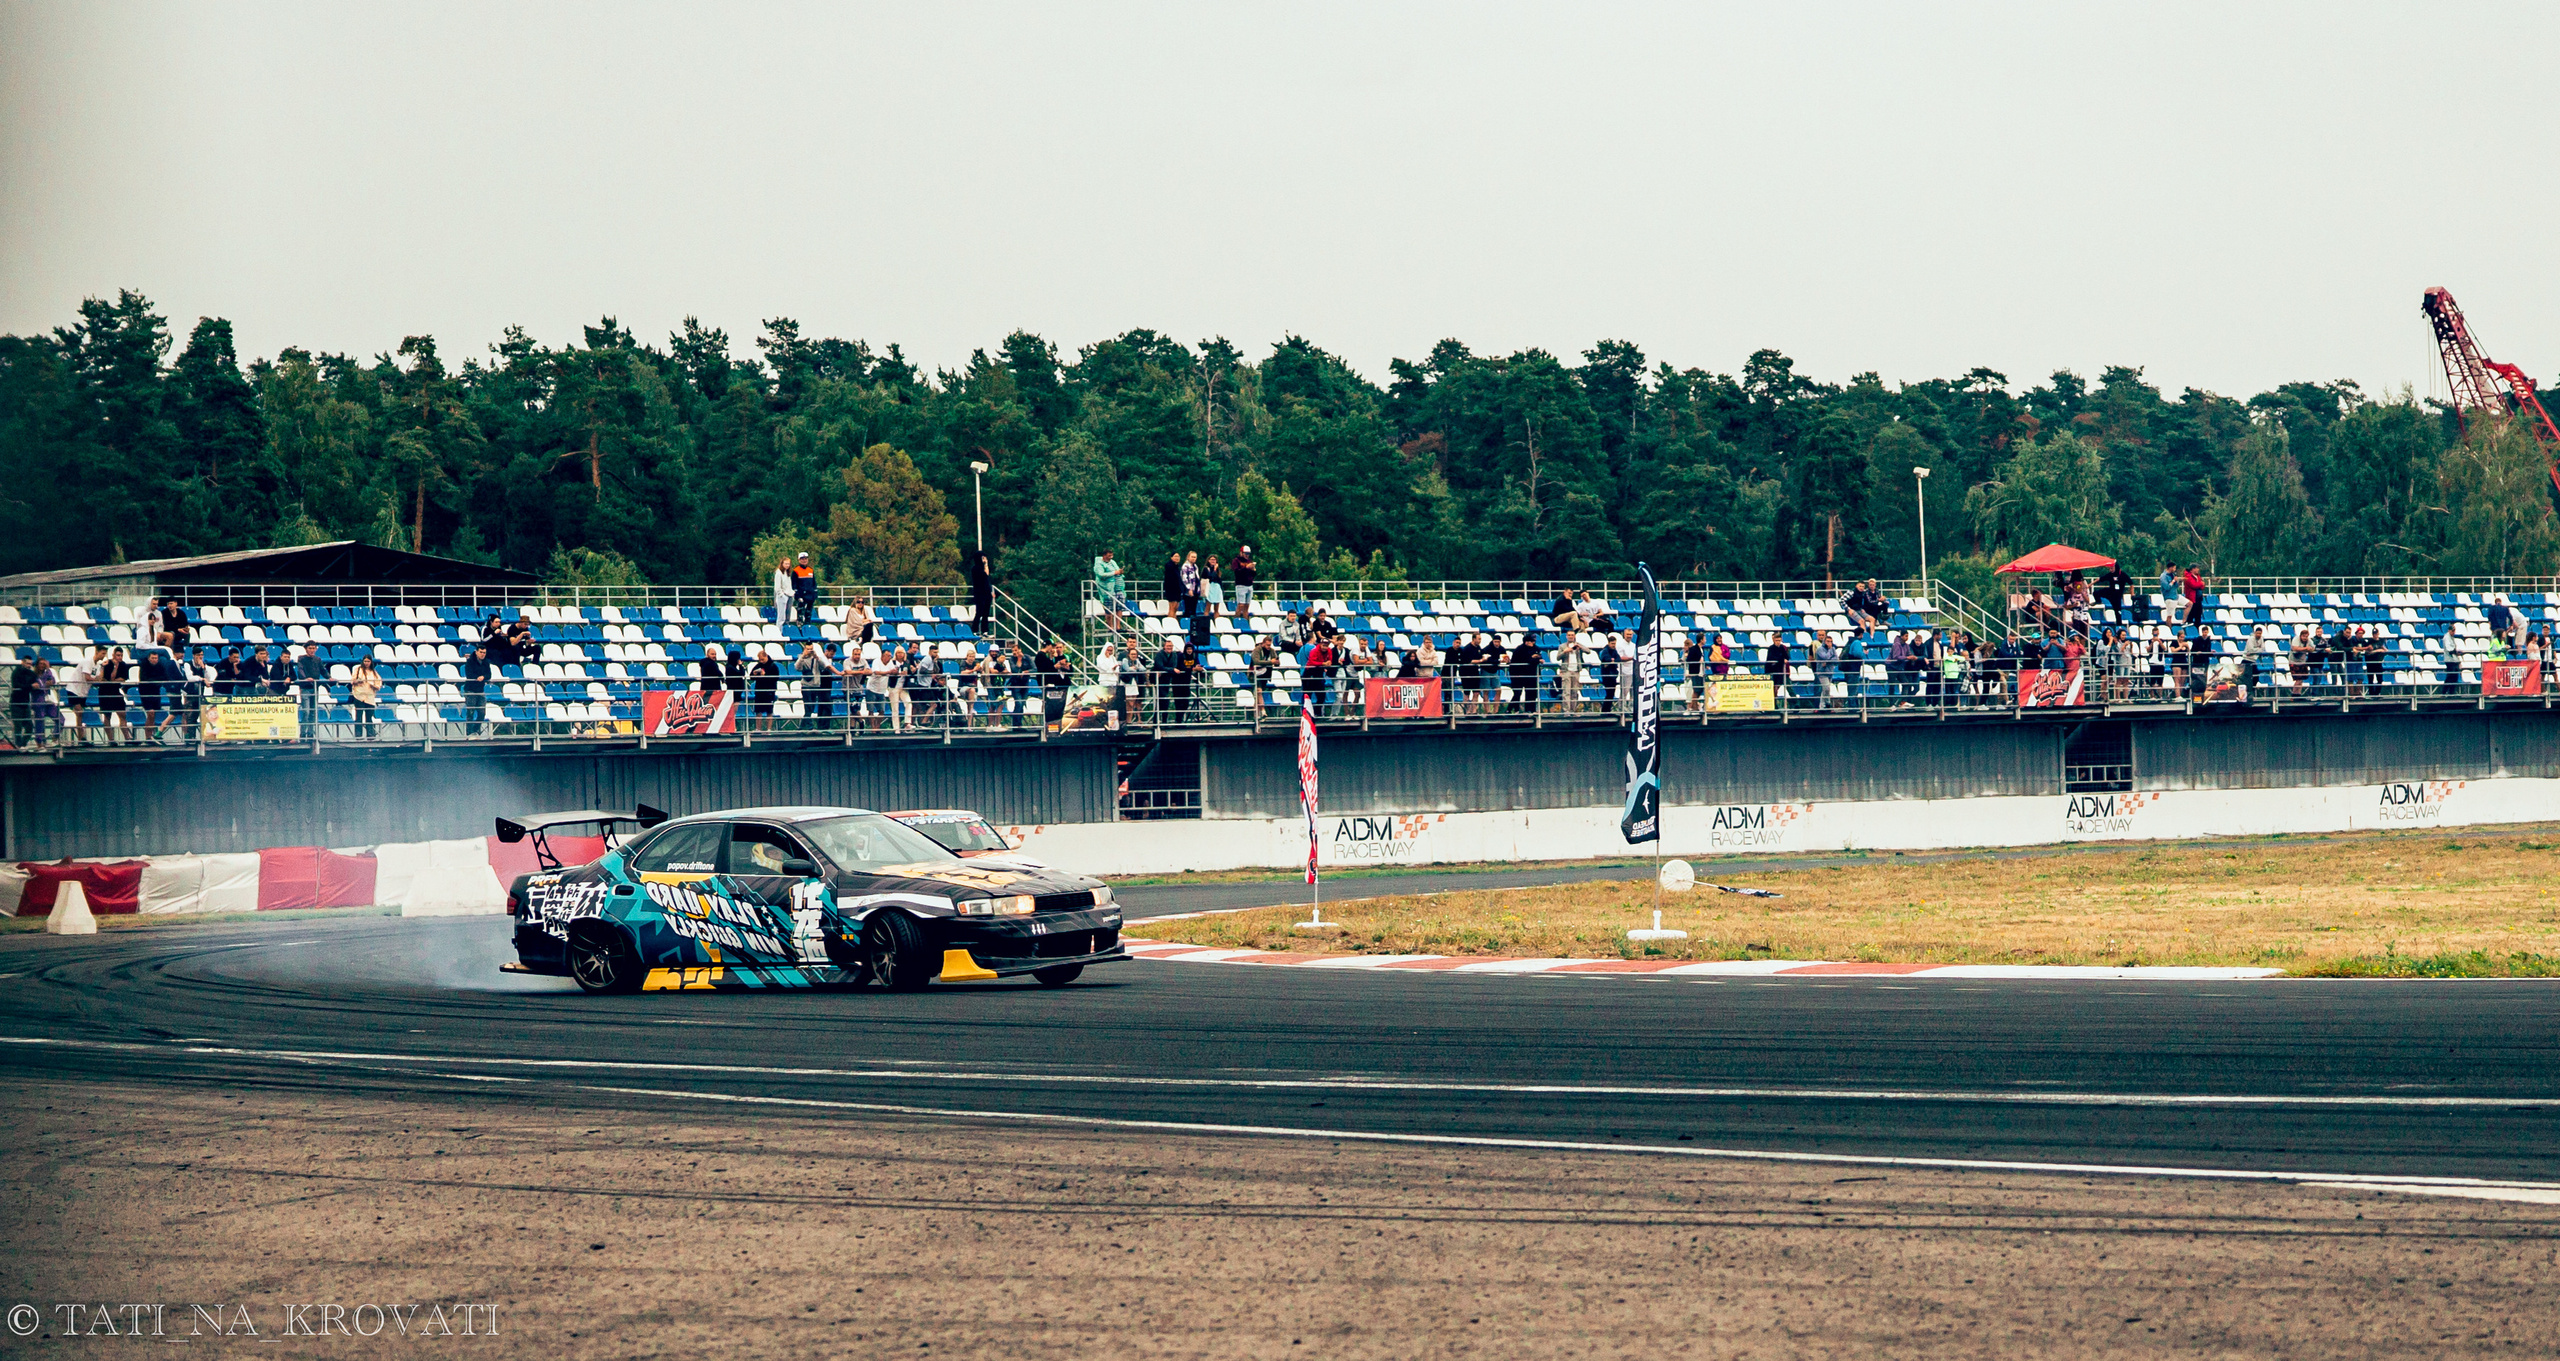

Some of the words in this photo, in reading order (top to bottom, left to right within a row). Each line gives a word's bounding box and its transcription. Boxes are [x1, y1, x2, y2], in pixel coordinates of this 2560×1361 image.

[1402, 685, 1424, 698] DRIFT
[1402, 698, 1419, 709] FUN
[2380, 783, 2424, 805] ADM
[2066, 795, 2114, 818] ADM
[2379, 805, 2442, 820] RACEWAY
[1712, 806, 1764, 829] ADM
[1335, 817, 1392, 841] ADM
[2066, 818, 2132, 834] RACEWAY
[1712, 830, 1784, 846] RACEWAY
[1334, 841, 1414, 859] RACEWAY
[666, 861, 714, 871] popov.driftone
